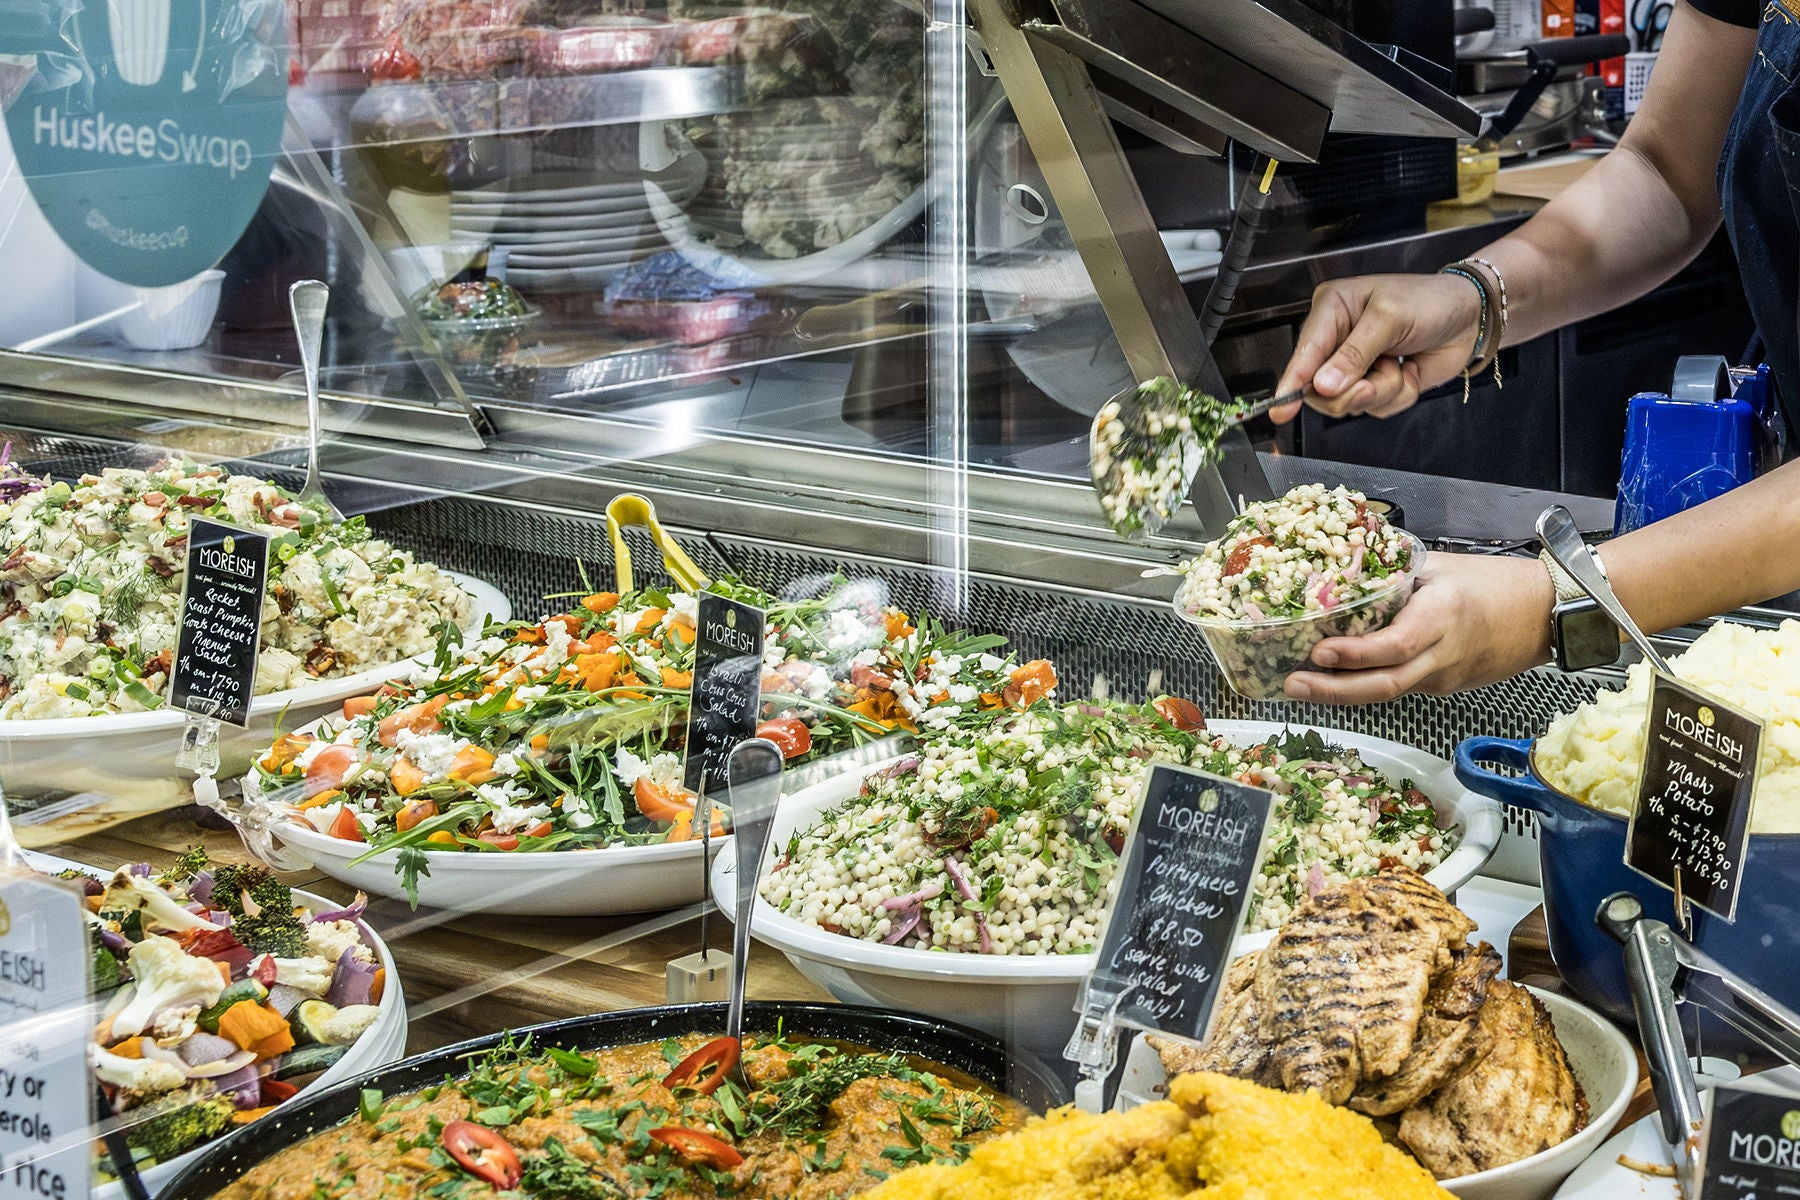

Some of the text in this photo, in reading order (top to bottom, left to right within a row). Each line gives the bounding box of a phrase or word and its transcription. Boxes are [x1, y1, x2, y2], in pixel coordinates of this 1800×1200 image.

[34, 105, 253, 179] HuskeeSwap
[200, 548, 256, 577] MOREISH
[185, 597, 213, 617] Roast
[183, 613, 208, 630] Goats
[210, 623, 244, 642] Cheese
[706, 620, 755, 654] MOREISH
[191, 631, 231, 654] Pinenut
[194, 645, 237, 668] Salad
[709, 663, 743, 686] Israeli
[700, 679, 747, 708] Cous Cous
[700, 695, 741, 724] Salad
[1665, 707, 1744, 763] MOREISH
[1666, 759, 1714, 796] Mash
[1664, 780, 1714, 817] Potato
[1157, 802, 1248, 844] MOREISH
[1146, 854, 1239, 896] Portuguese
[1149, 884, 1224, 920] Chicken
[1150, 918, 1203, 948] $8.50
[0, 954, 46, 991] EISH
[1129, 970, 1183, 998] salad
[1174, 960, 1212, 984] with
[24, 1076, 45, 1100] or
[15, 1156, 66, 1200] rice
